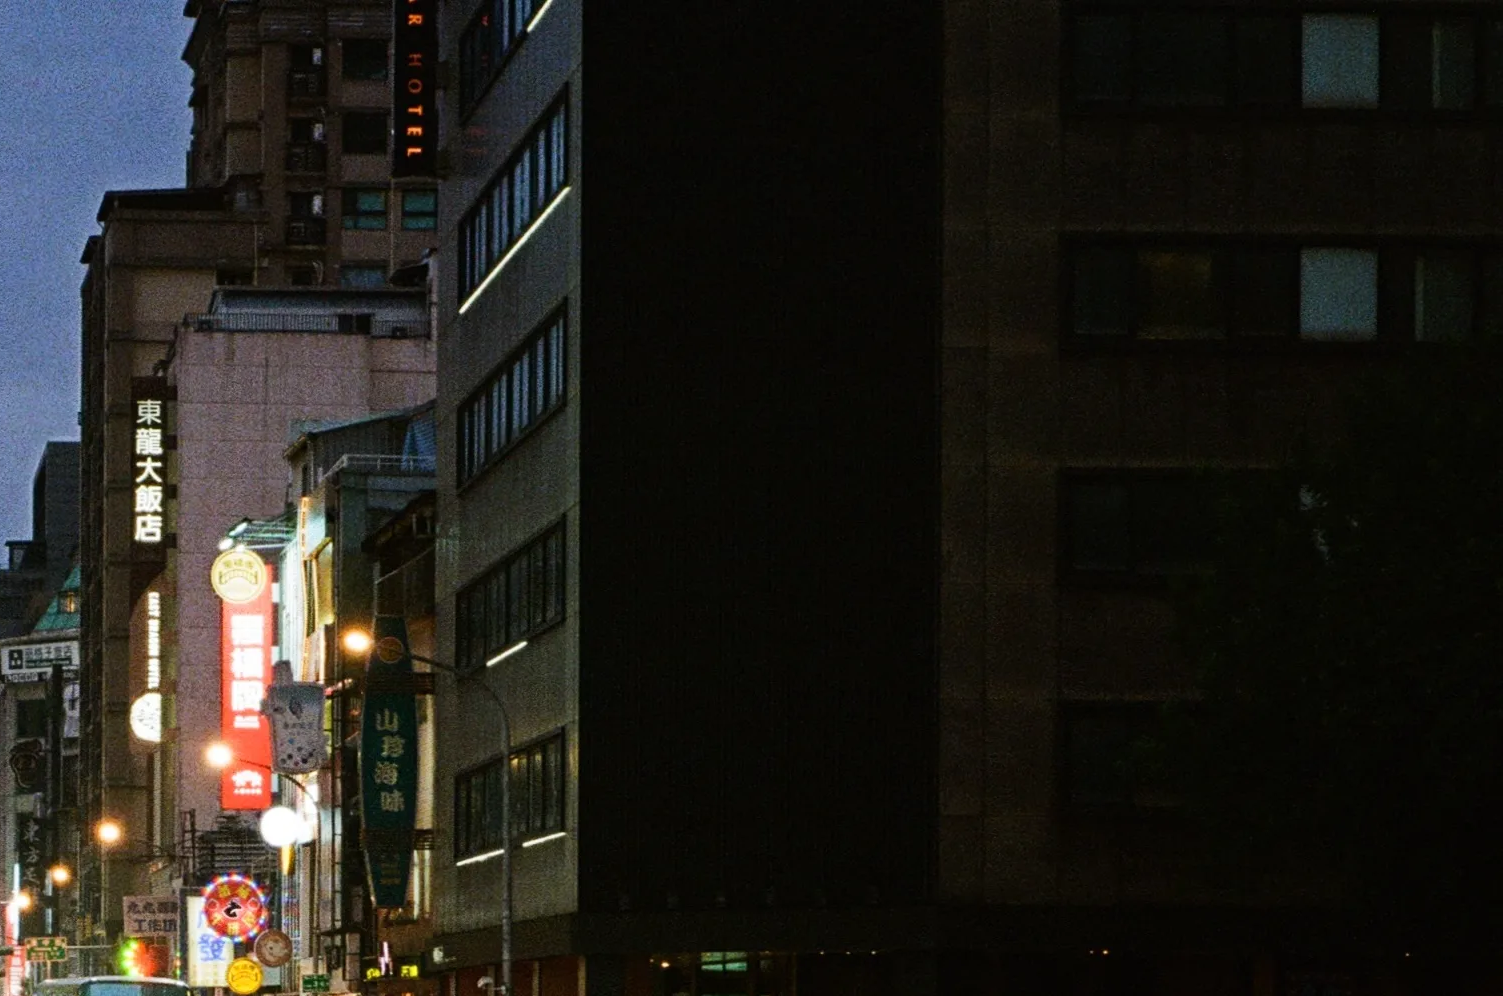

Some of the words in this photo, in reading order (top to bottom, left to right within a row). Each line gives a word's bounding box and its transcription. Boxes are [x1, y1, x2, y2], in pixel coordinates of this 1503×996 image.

[406, 0, 423, 26] R
[406, 52, 423, 157] HOTEL
[134, 399, 163, 543] 東龍大飯店
